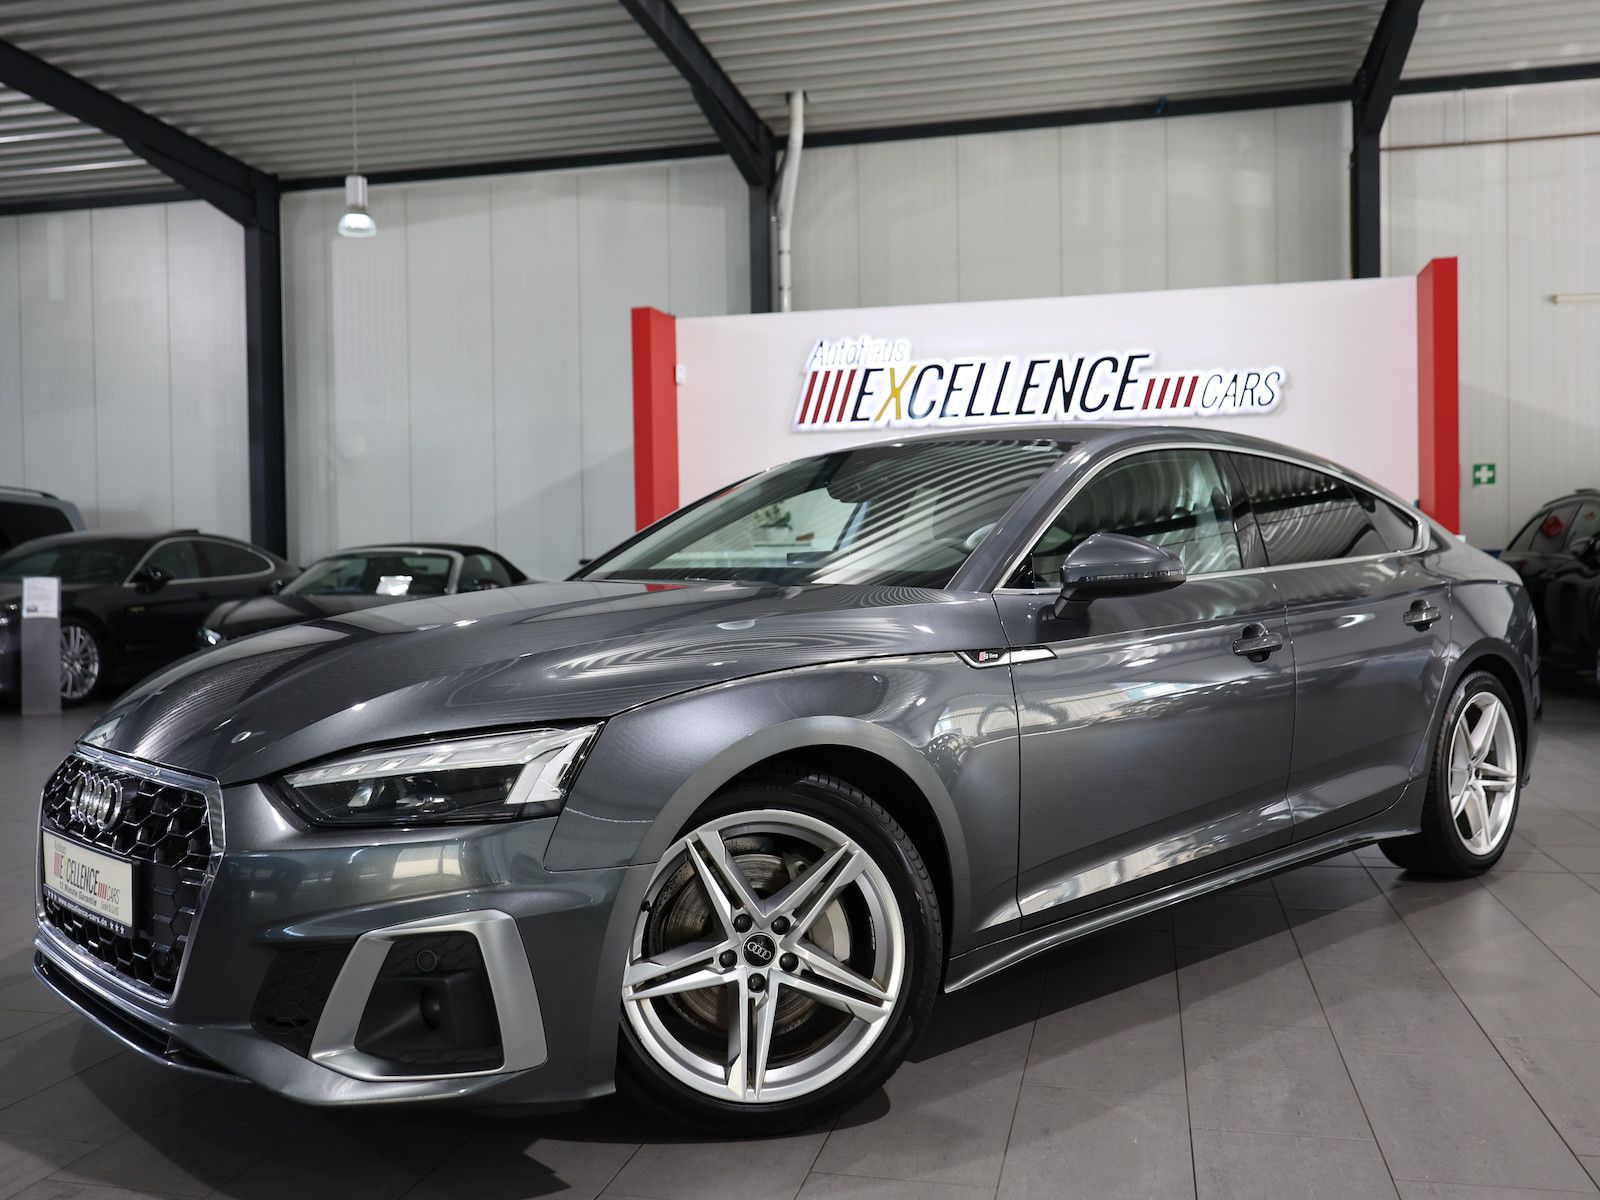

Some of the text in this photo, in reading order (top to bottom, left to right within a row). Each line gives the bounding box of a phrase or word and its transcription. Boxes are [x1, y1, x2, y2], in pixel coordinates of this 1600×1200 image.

[809, 339, 906, 367] Autohaus
[850, 354, 1280, 421] EXCELLENCE CARS
[107, 885, 120, 905] CARS
